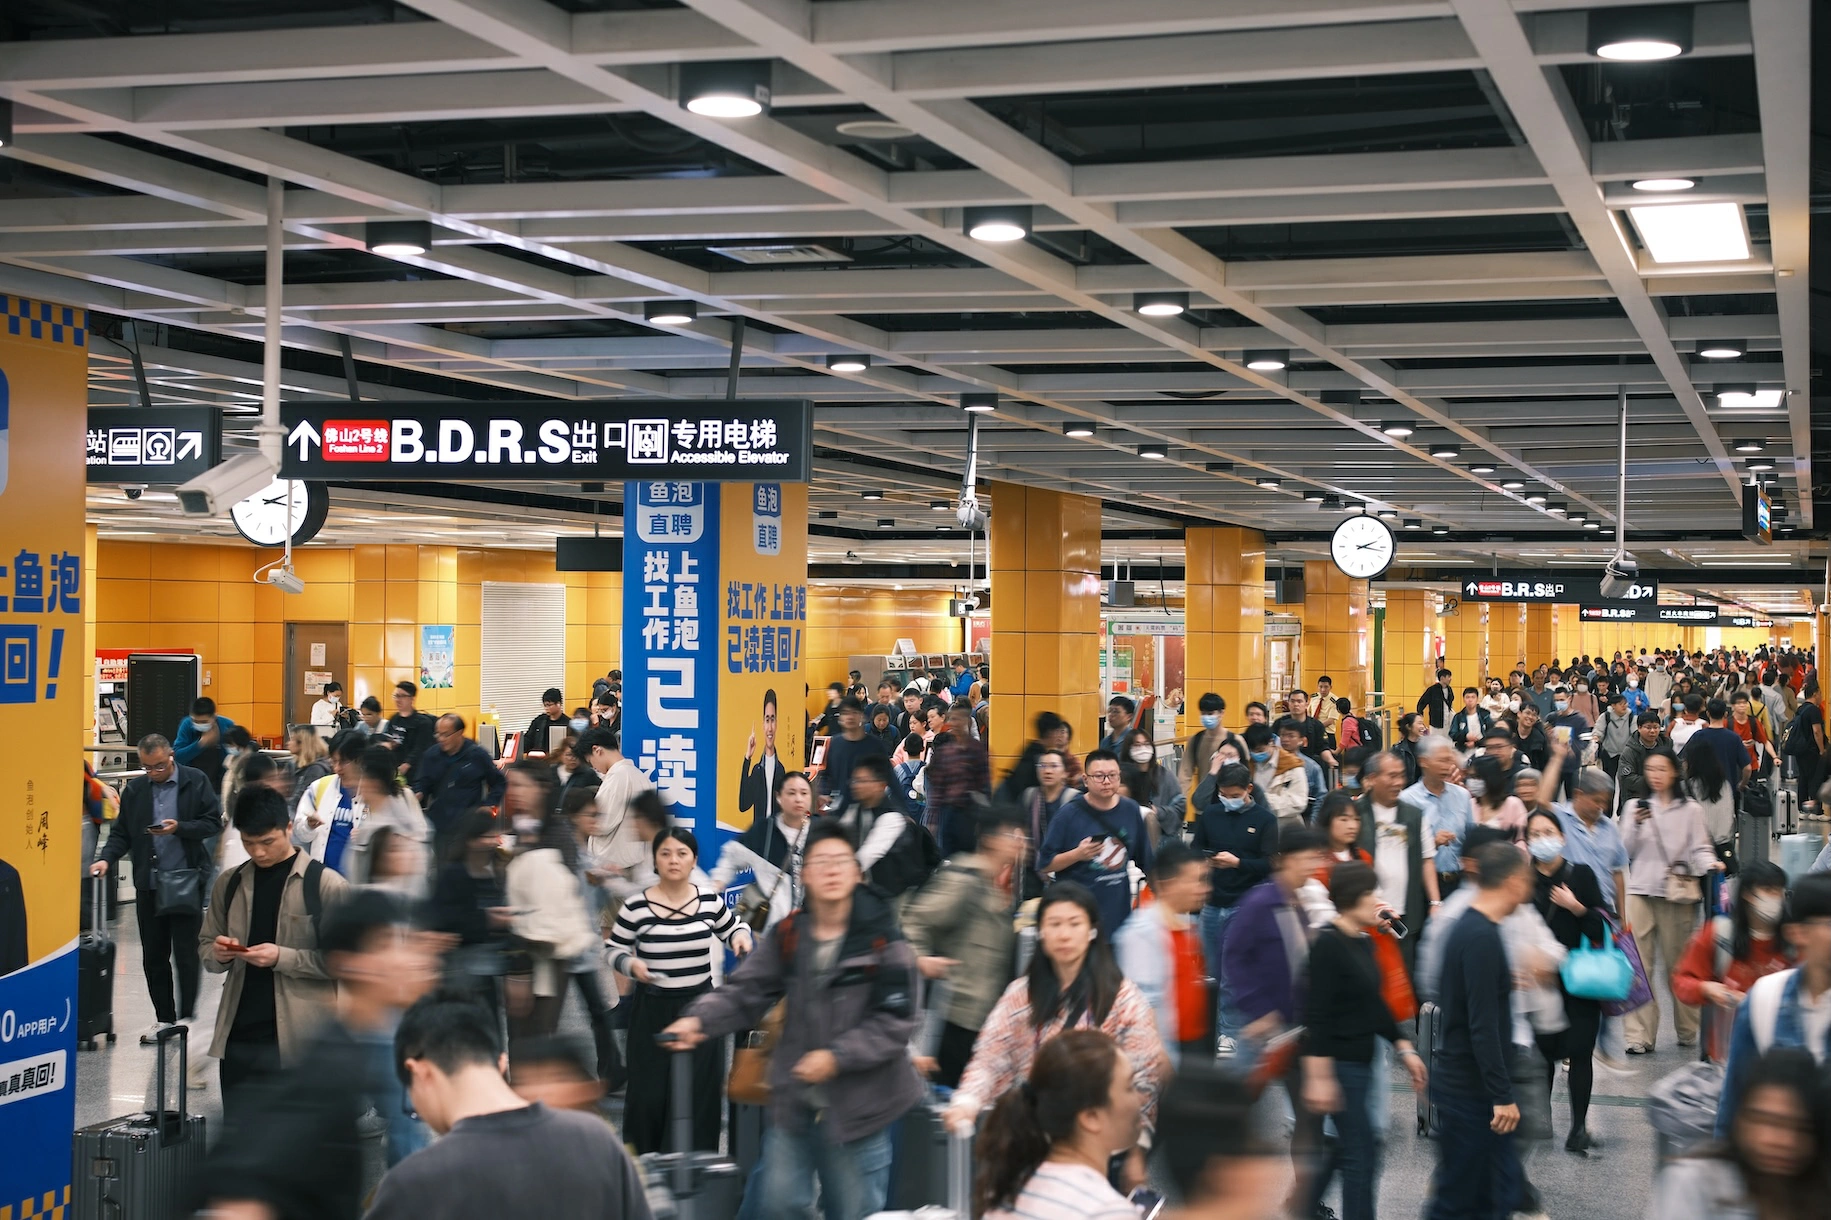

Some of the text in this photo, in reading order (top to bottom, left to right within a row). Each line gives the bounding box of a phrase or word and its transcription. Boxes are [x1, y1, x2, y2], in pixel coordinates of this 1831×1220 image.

[324, 427, 388, 443] 佛山2号线
[391, 419, 571, 463] B.D.R.S
[572, 419, 627, 449] 出口
[670, 419, 777, 449] 专用电梯
[86, 456, 107, 465] ation
[359, 444, 376, 453] Line
[377, 444, 383, 453] 2
[572, 450, 598, 463] Exit
[670, 450, 789, 464] Accessible Elevator
[649, 482, 693, 503] 鱼泡
[757, 485, 778, 512] 鱼泡
[649, 513, 692, 536] 直聘
[757, 523, 778, 549] 直聘
[642, 551, 670, 650] 找工作
[672, 551, 699, 650] 上鱼泡
[727, 581, 806, 621] 找工作 上鱼泡
[1501, 582, 1546, 598] B.R.S
[1629, 585, 1642, 599] D
[728, 625, 800, 673] 已读真回!
[639, 657, 699, 834] 已读
[17, 1016, 57, 1039] APP用户
